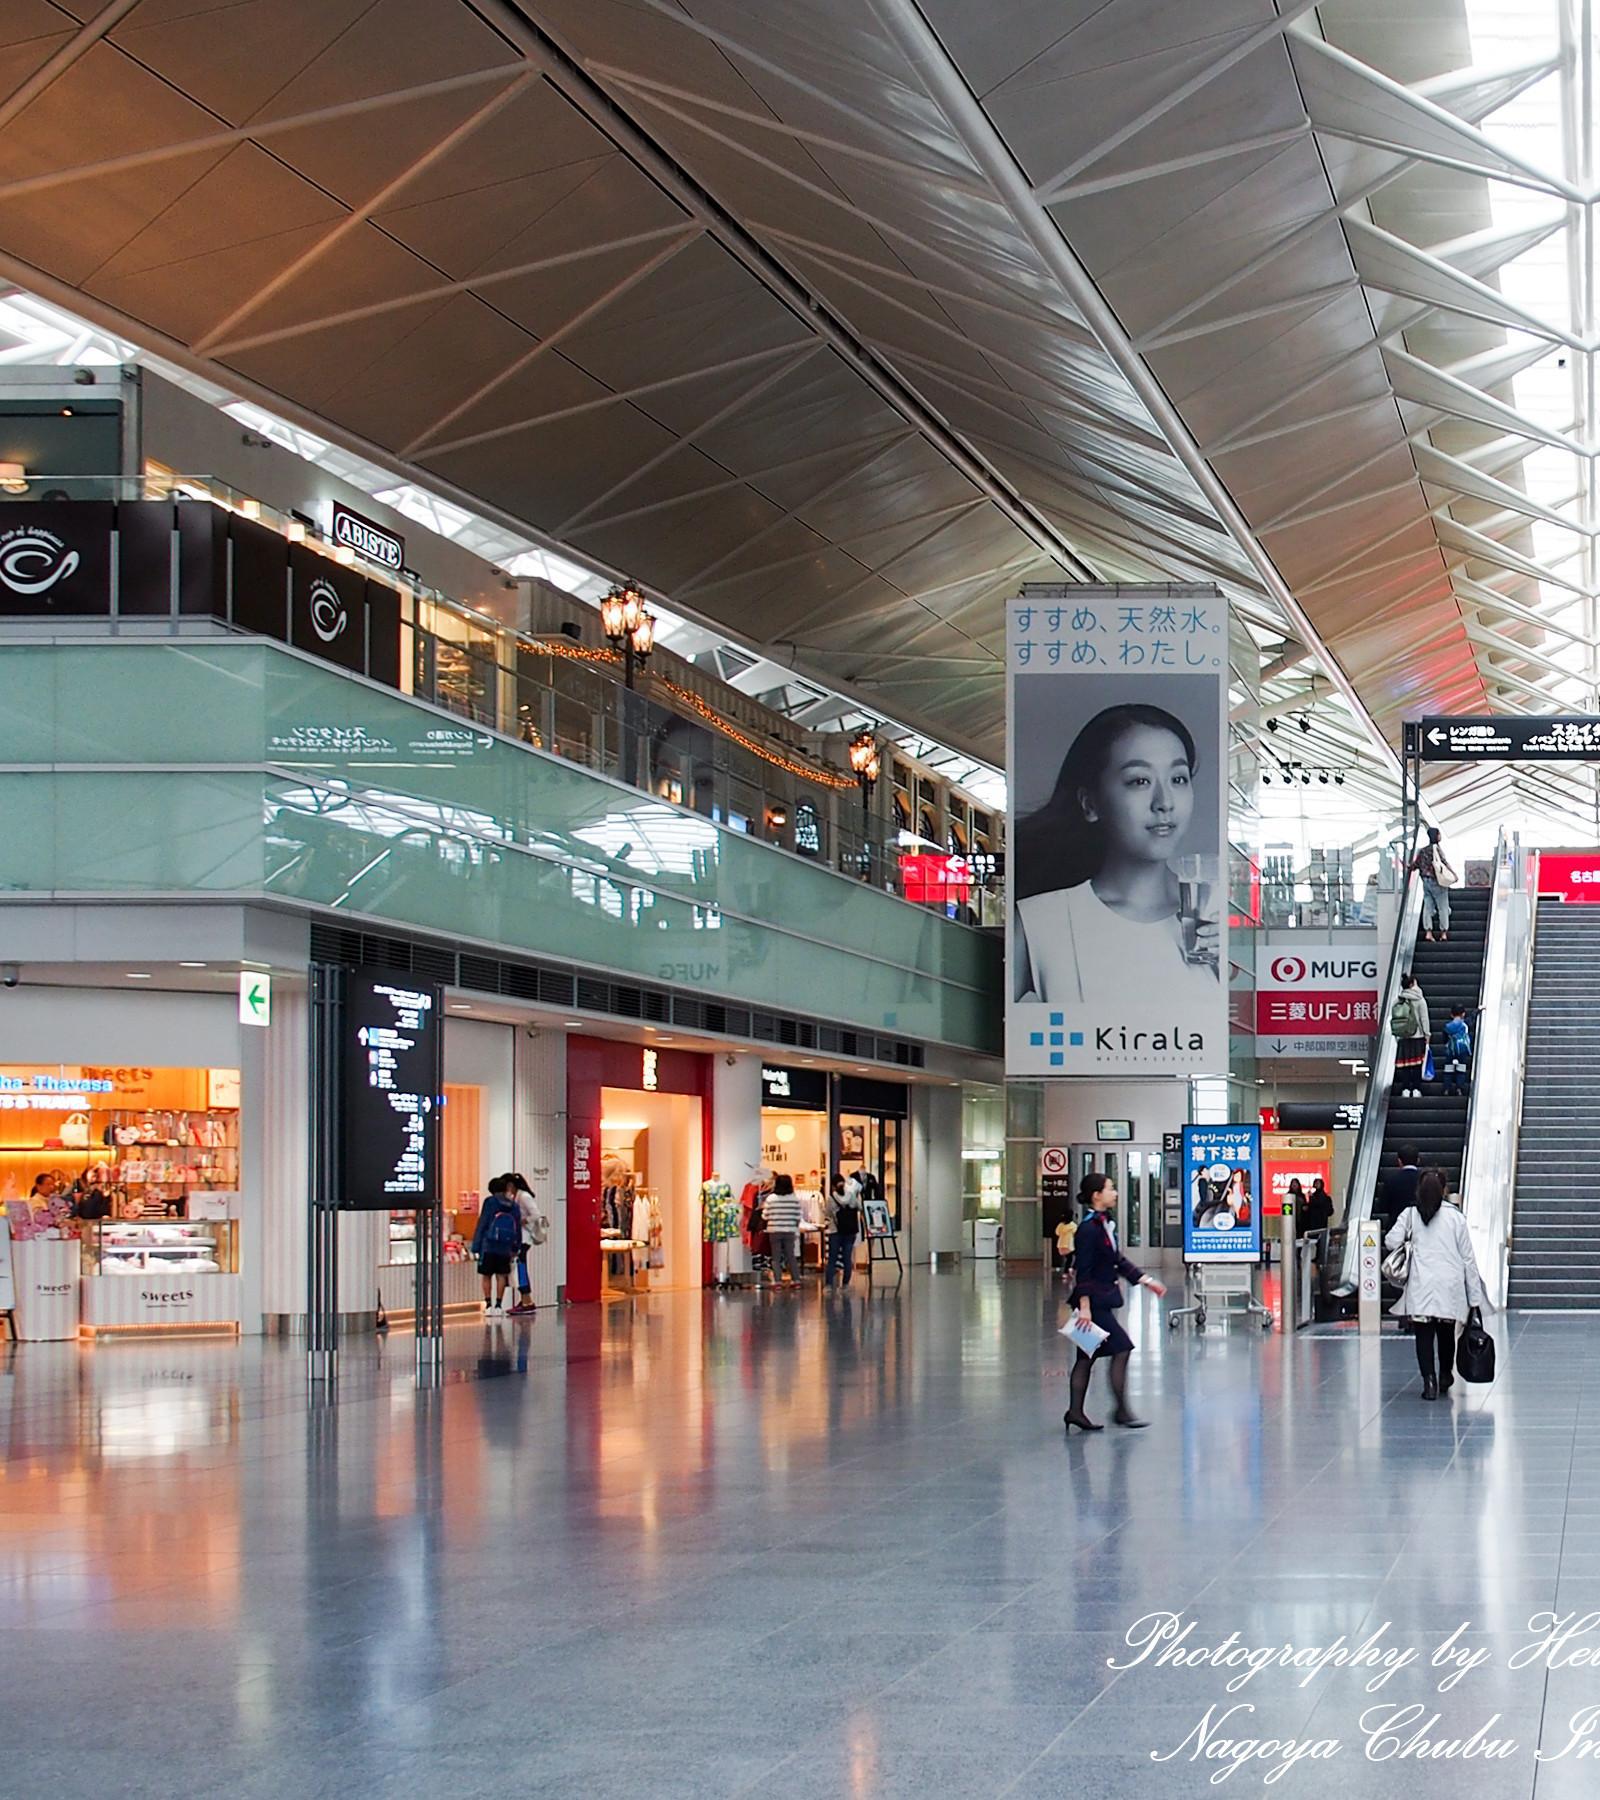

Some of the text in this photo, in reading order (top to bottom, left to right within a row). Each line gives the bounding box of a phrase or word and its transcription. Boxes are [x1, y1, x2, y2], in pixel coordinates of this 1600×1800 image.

[340, 519, 399, 565] ABISTE
[1014, 606, 1221, 633] すすめ、天然水。
[1014, 640, 1221, 666] すすめ、わたし。
[1311, 961, 1377, 978] MUFG
[1096, 1026, 1204, 1051] Kirala
[33, 1075, 113, 1092] Thavasa
[1165, 1135, 1181, 1151] 3F
[1191, 1133, 1251, 1144] キャリーバッグ
[1191, 1146, 1252, 1161] 落下注意
[37, 1284, 71, 1293] sweets
[141, 1289, 194, 1303] sweets
